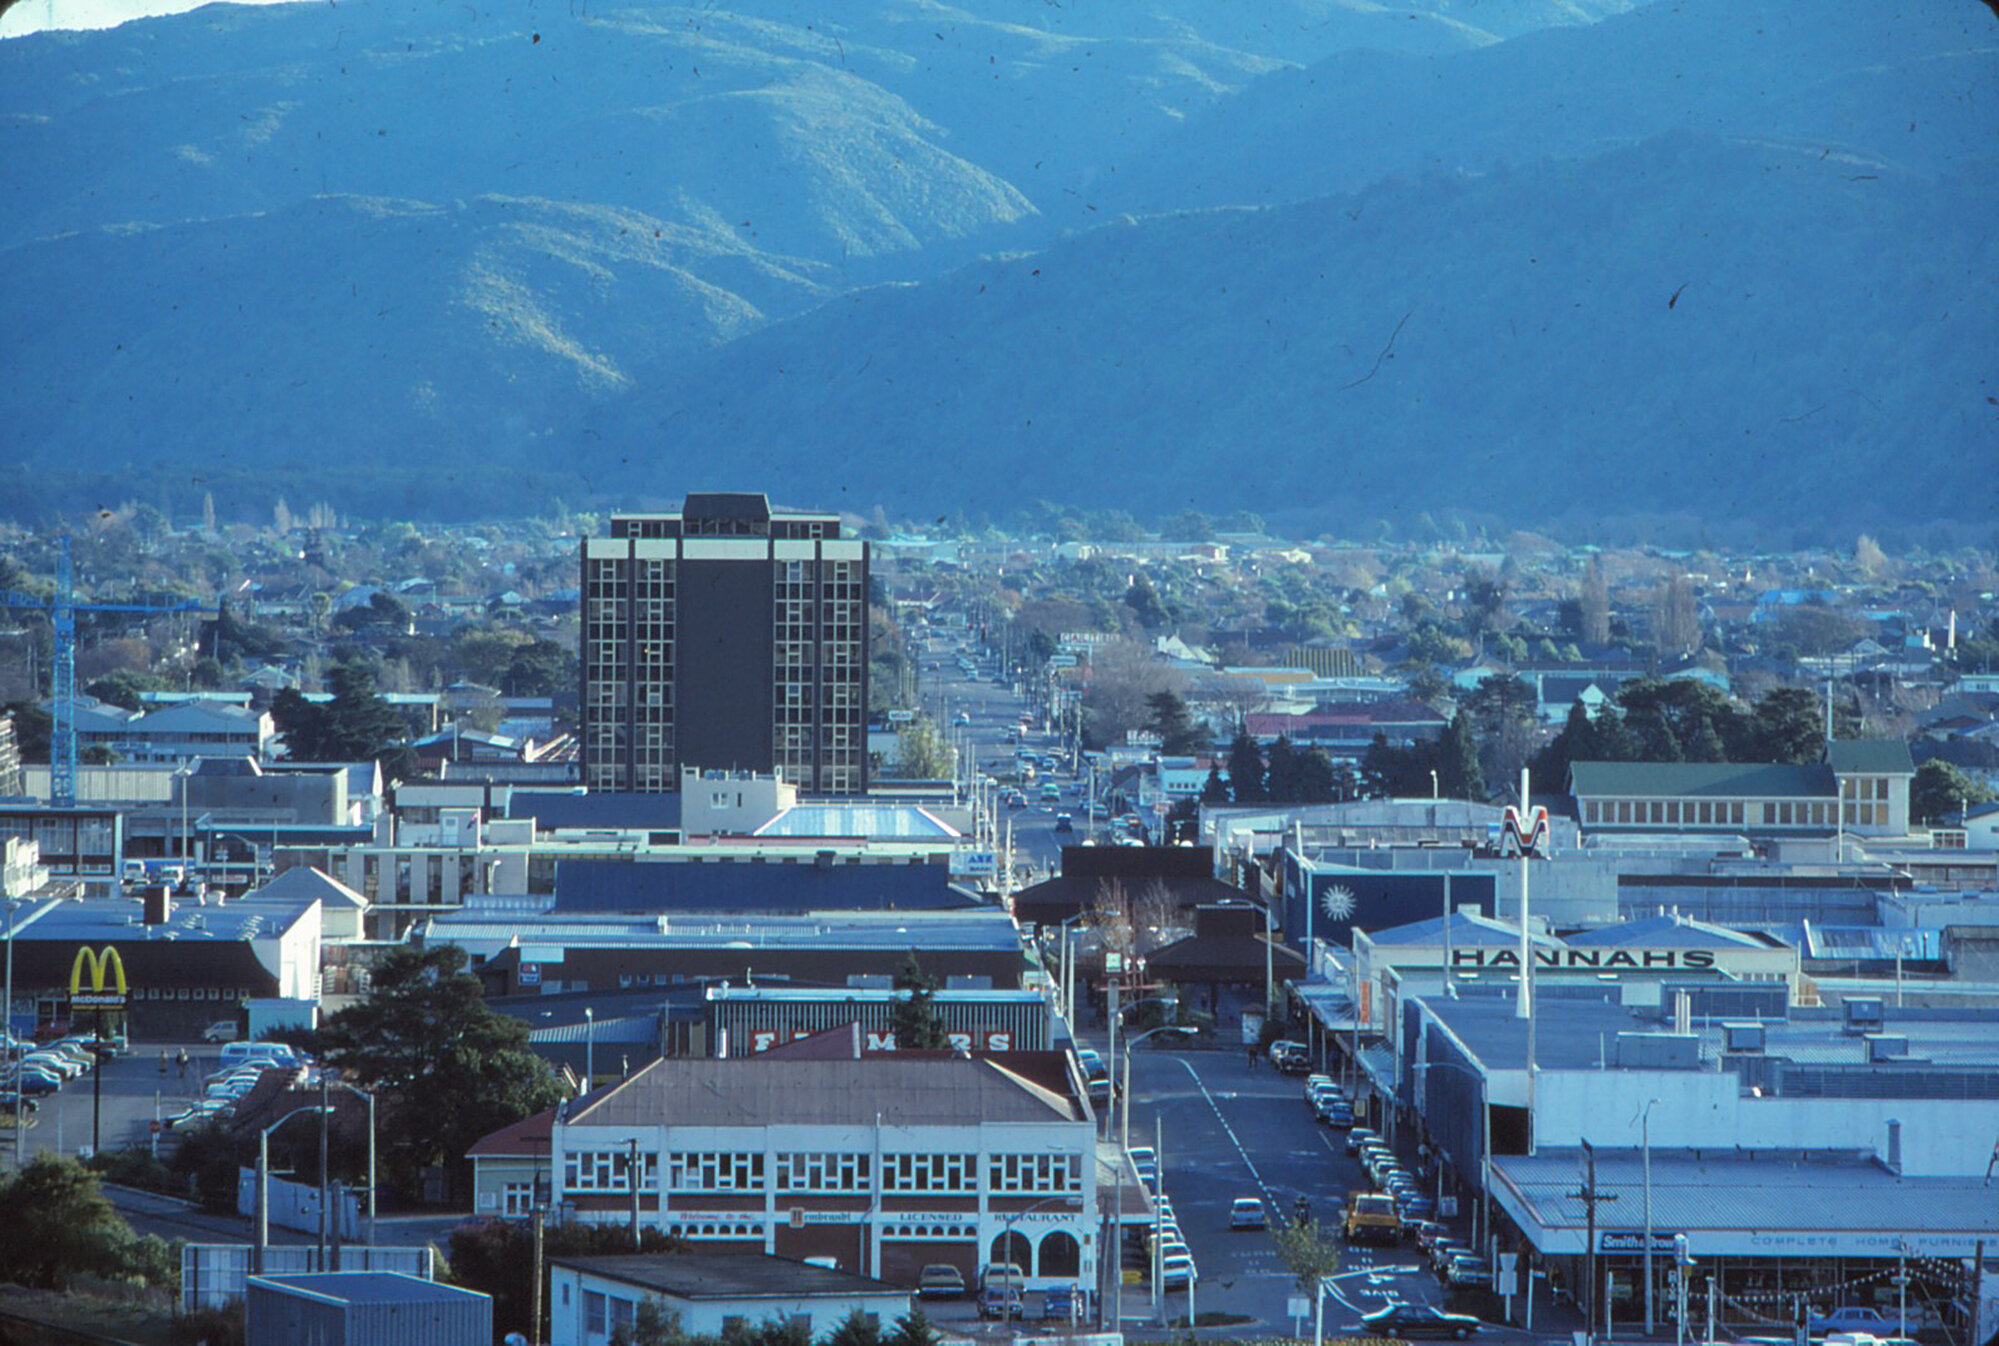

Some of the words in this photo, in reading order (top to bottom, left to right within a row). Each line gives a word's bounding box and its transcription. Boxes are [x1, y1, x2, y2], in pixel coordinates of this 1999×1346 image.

[1452, 950, 1715, 967] HANNAHS
[70, 995, 126, 1004] McDonald's
[754, 1033, 1010, 1051] FMRS
[900, 1213, 962, 1222] LICENSED
[1751, 1237, 1838, 1246] COMPLETE
